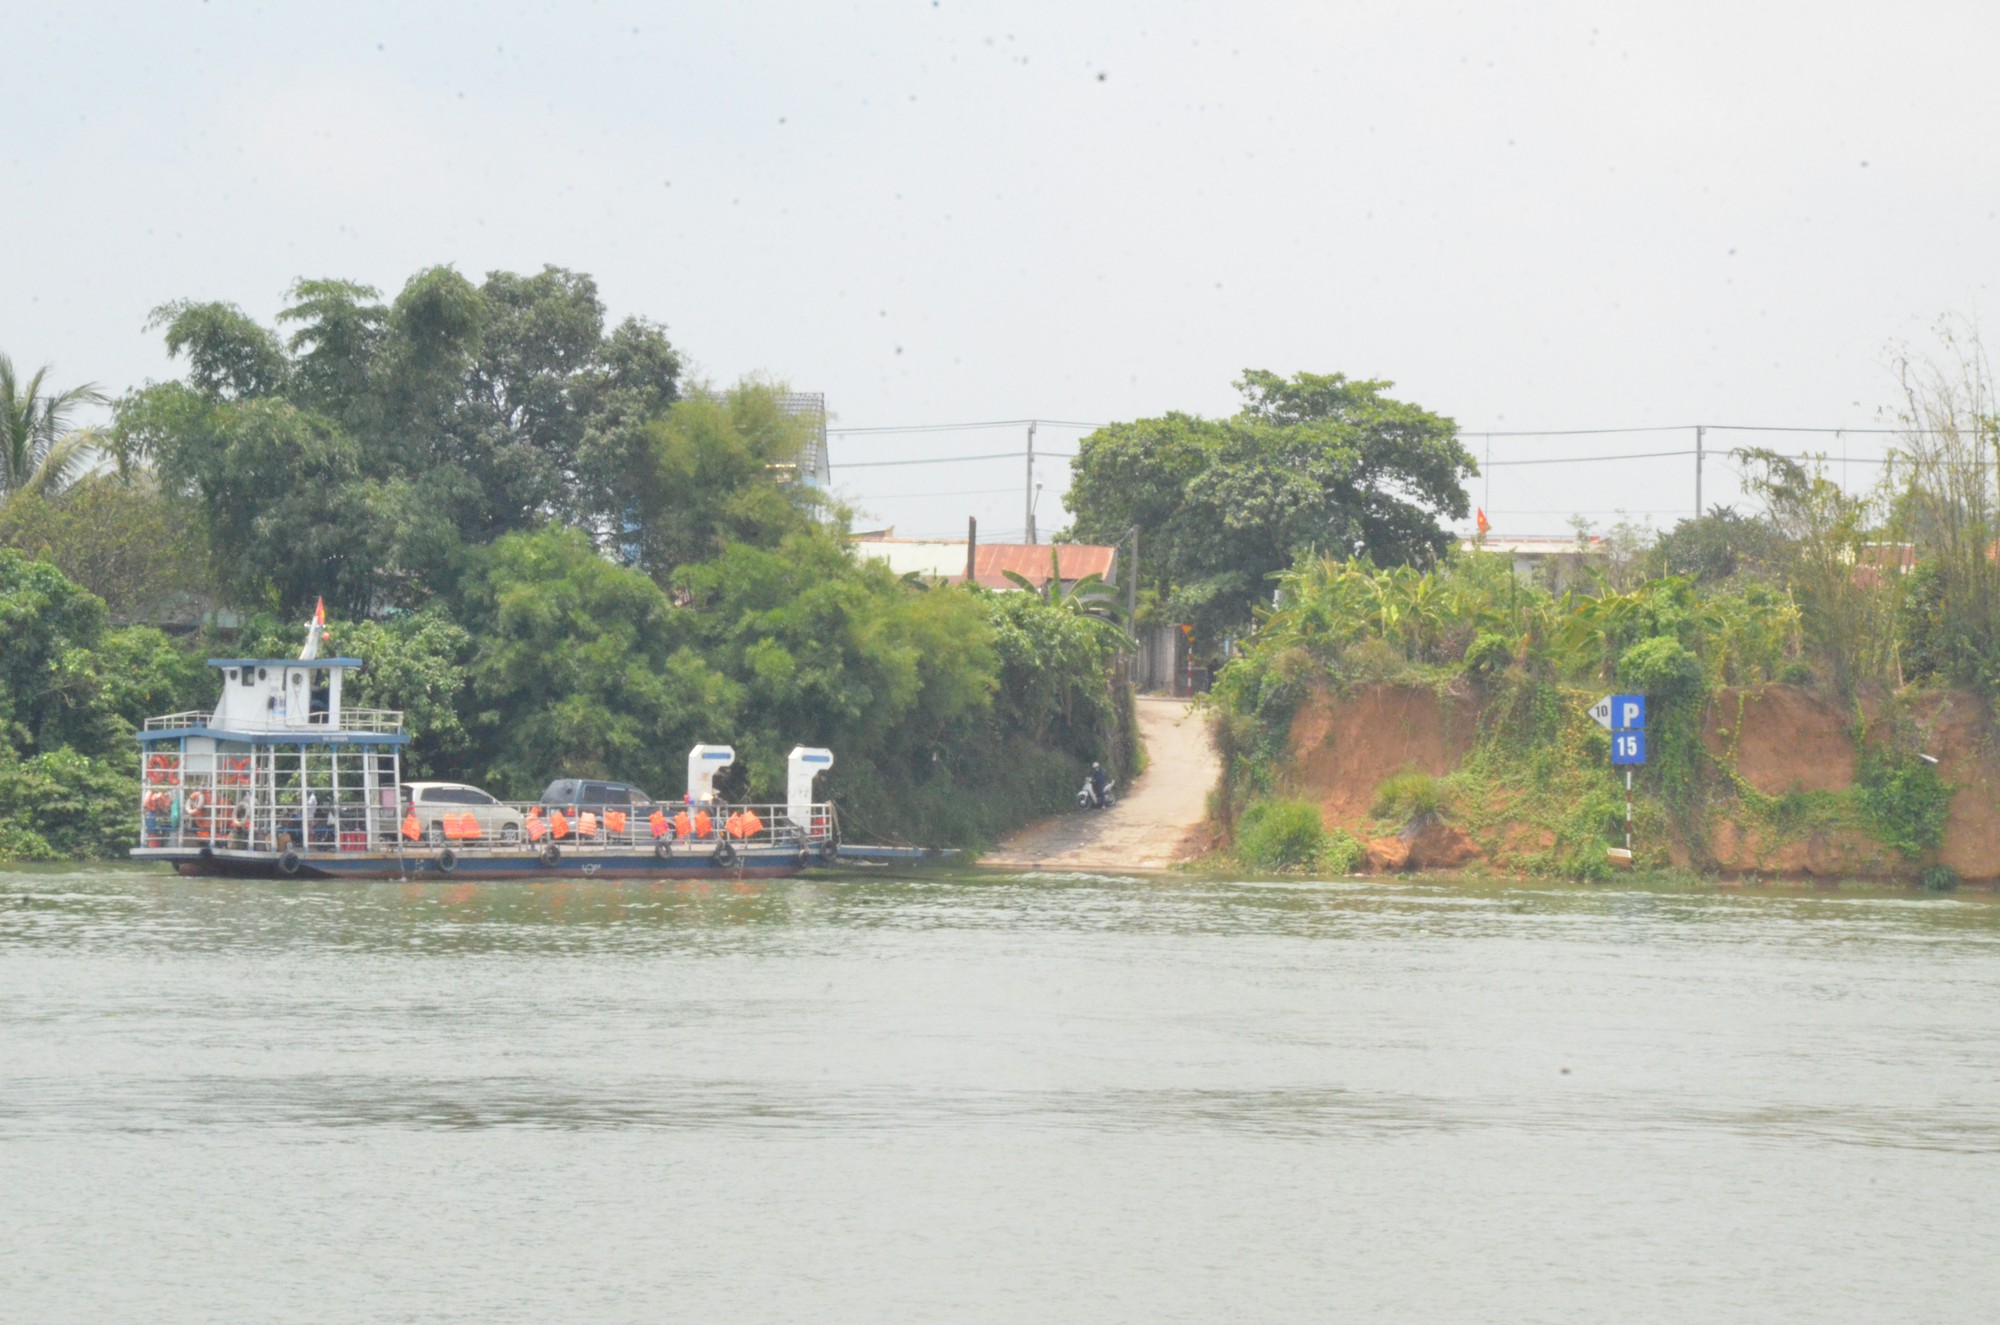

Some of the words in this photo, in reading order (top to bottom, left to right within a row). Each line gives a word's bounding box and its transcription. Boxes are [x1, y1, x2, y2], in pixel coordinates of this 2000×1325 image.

[1595, 705, 1608, 718] 10
[1623, 703, 1639, 727] P
[1617, 736, 1637, 756] 15
